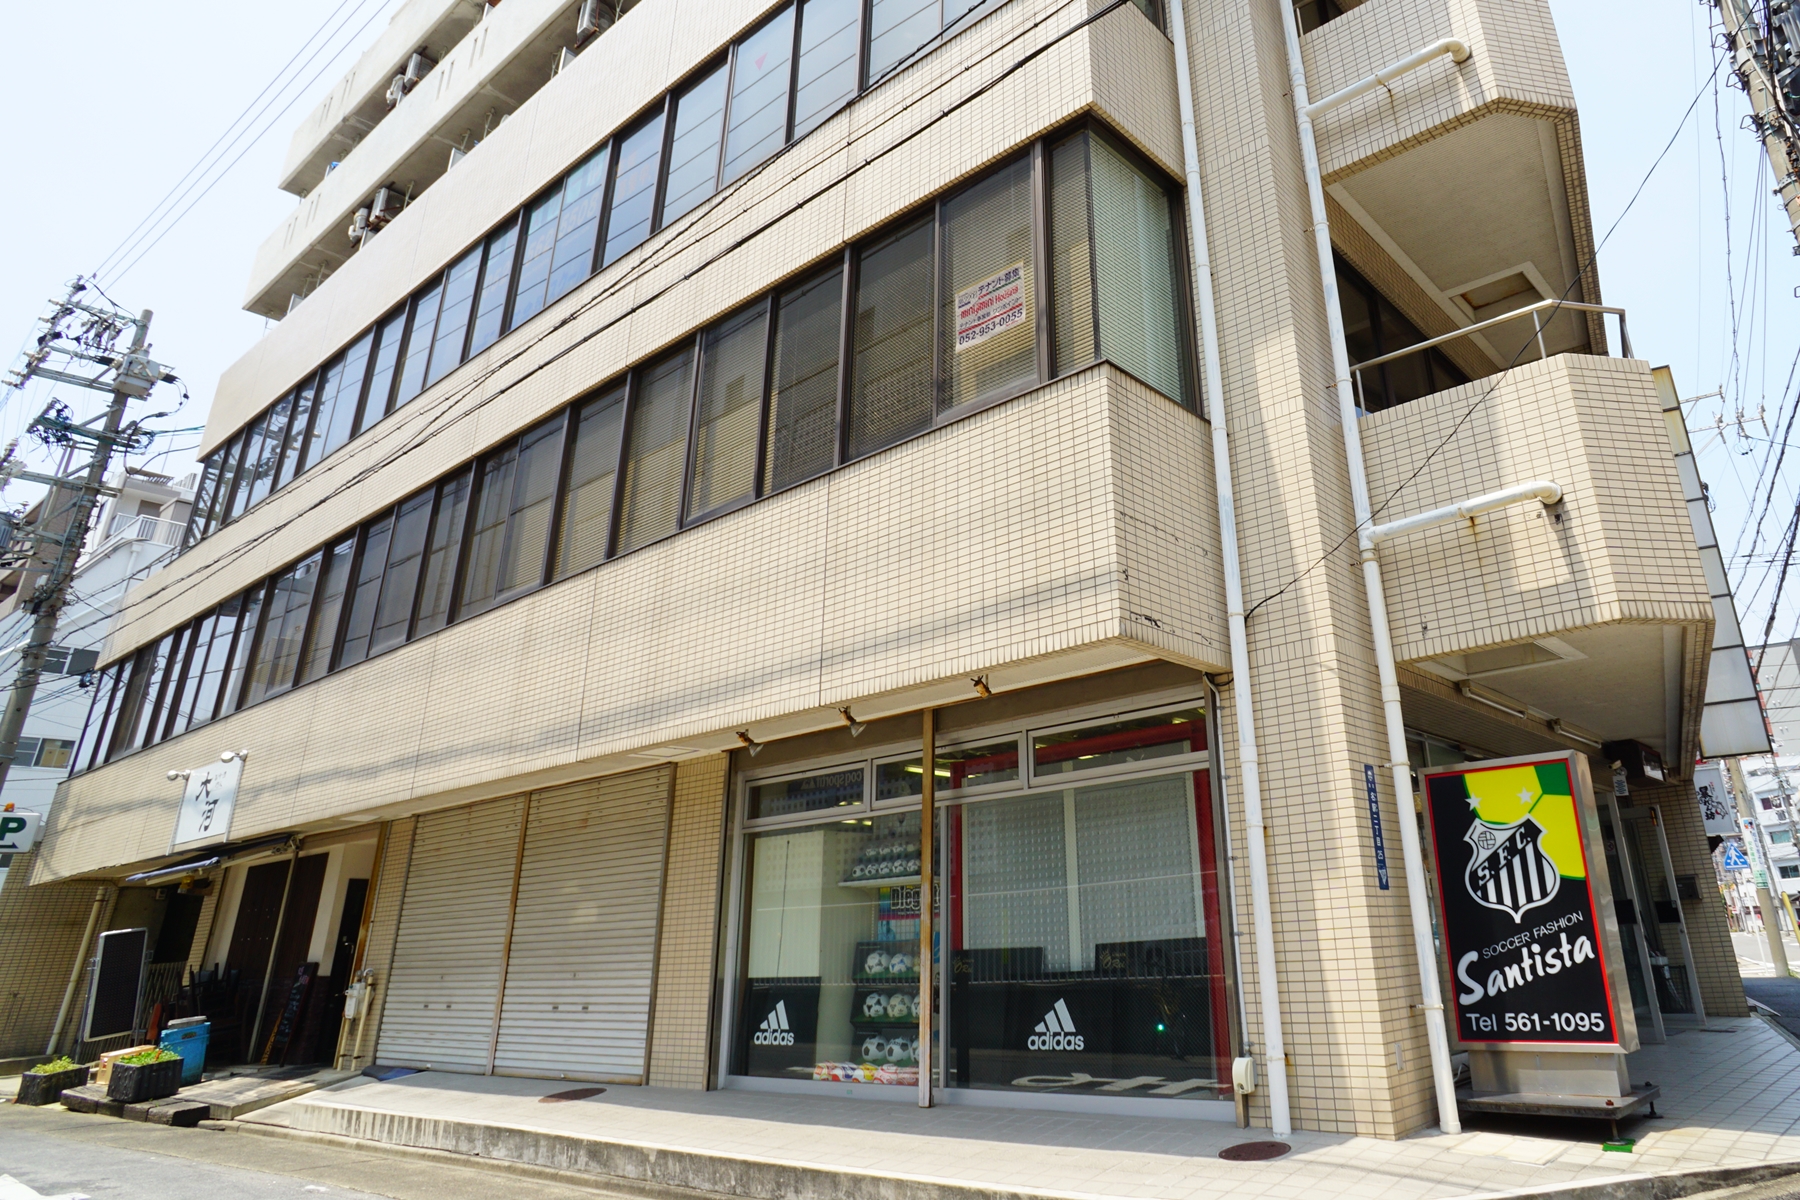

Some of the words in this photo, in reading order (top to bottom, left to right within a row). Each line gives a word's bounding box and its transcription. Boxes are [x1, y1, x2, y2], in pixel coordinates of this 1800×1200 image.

[959, 307, 1023, 345] 052-953-0055
[0, 817, 27, 841] P
[1482, 931, 1532, 959] SOCCER
[1533, 910, 1584, 937] FASHION
[1457, 932, 1596, 1006] Santista
[1466, 1013, 1497, 1032] Tel
[1504, 1012, 1606, 1032] 561-1095
[753, 1028, 795, 1046] adidas
[1027, 1031, 1085, 1051] adidas
